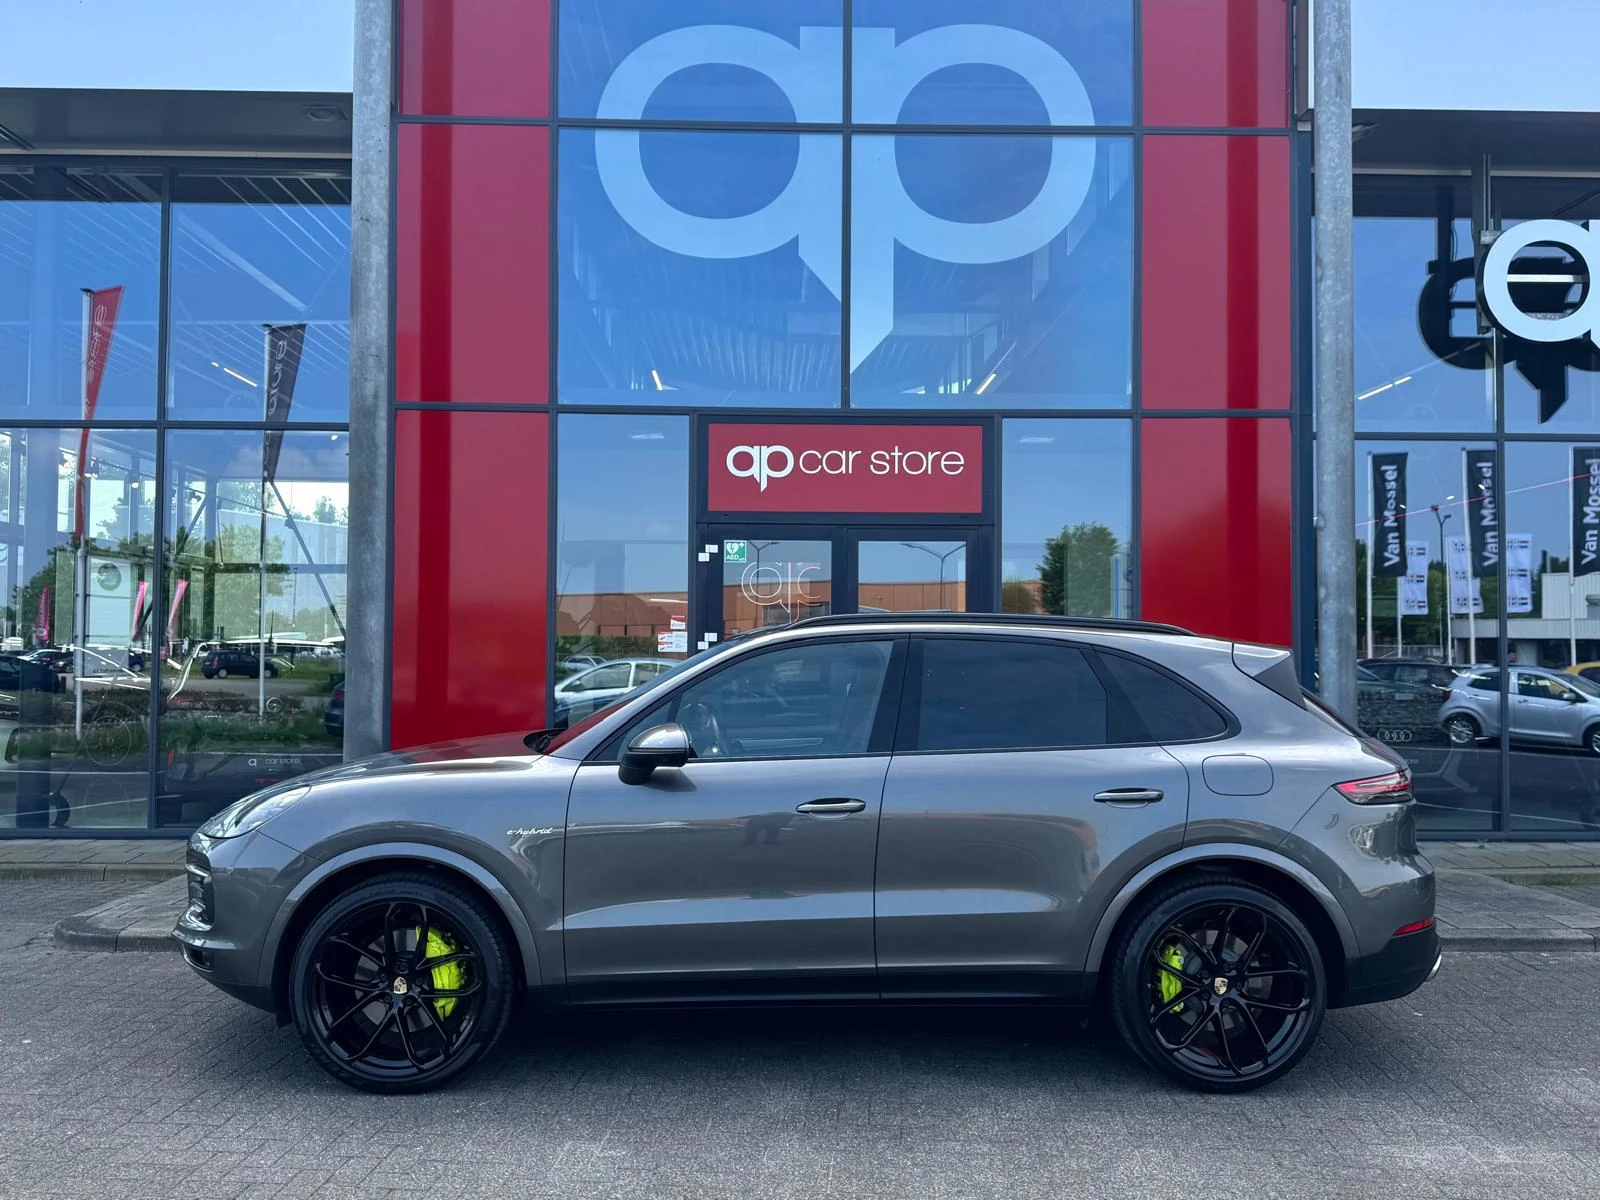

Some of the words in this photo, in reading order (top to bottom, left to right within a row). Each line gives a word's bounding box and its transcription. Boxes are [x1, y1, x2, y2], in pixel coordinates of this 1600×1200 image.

[595, 23, 1096, 374] ap
[726, 445, 794, 492] ap
[799, 450, 862, 474] car
[869, 446, 965, 475] store
[1583, 458, 1600, 524] Mossel
[1381, 464, 1398, 527] Mossel
[1477, 461, 1495, 526] Mossel
[1384, 532, 1399, 567] Van
[1482, 531, 1498, 565] Van
[1581, 529, 1598, 565] Van
[506, 827, 553, 838] e-hybrid
